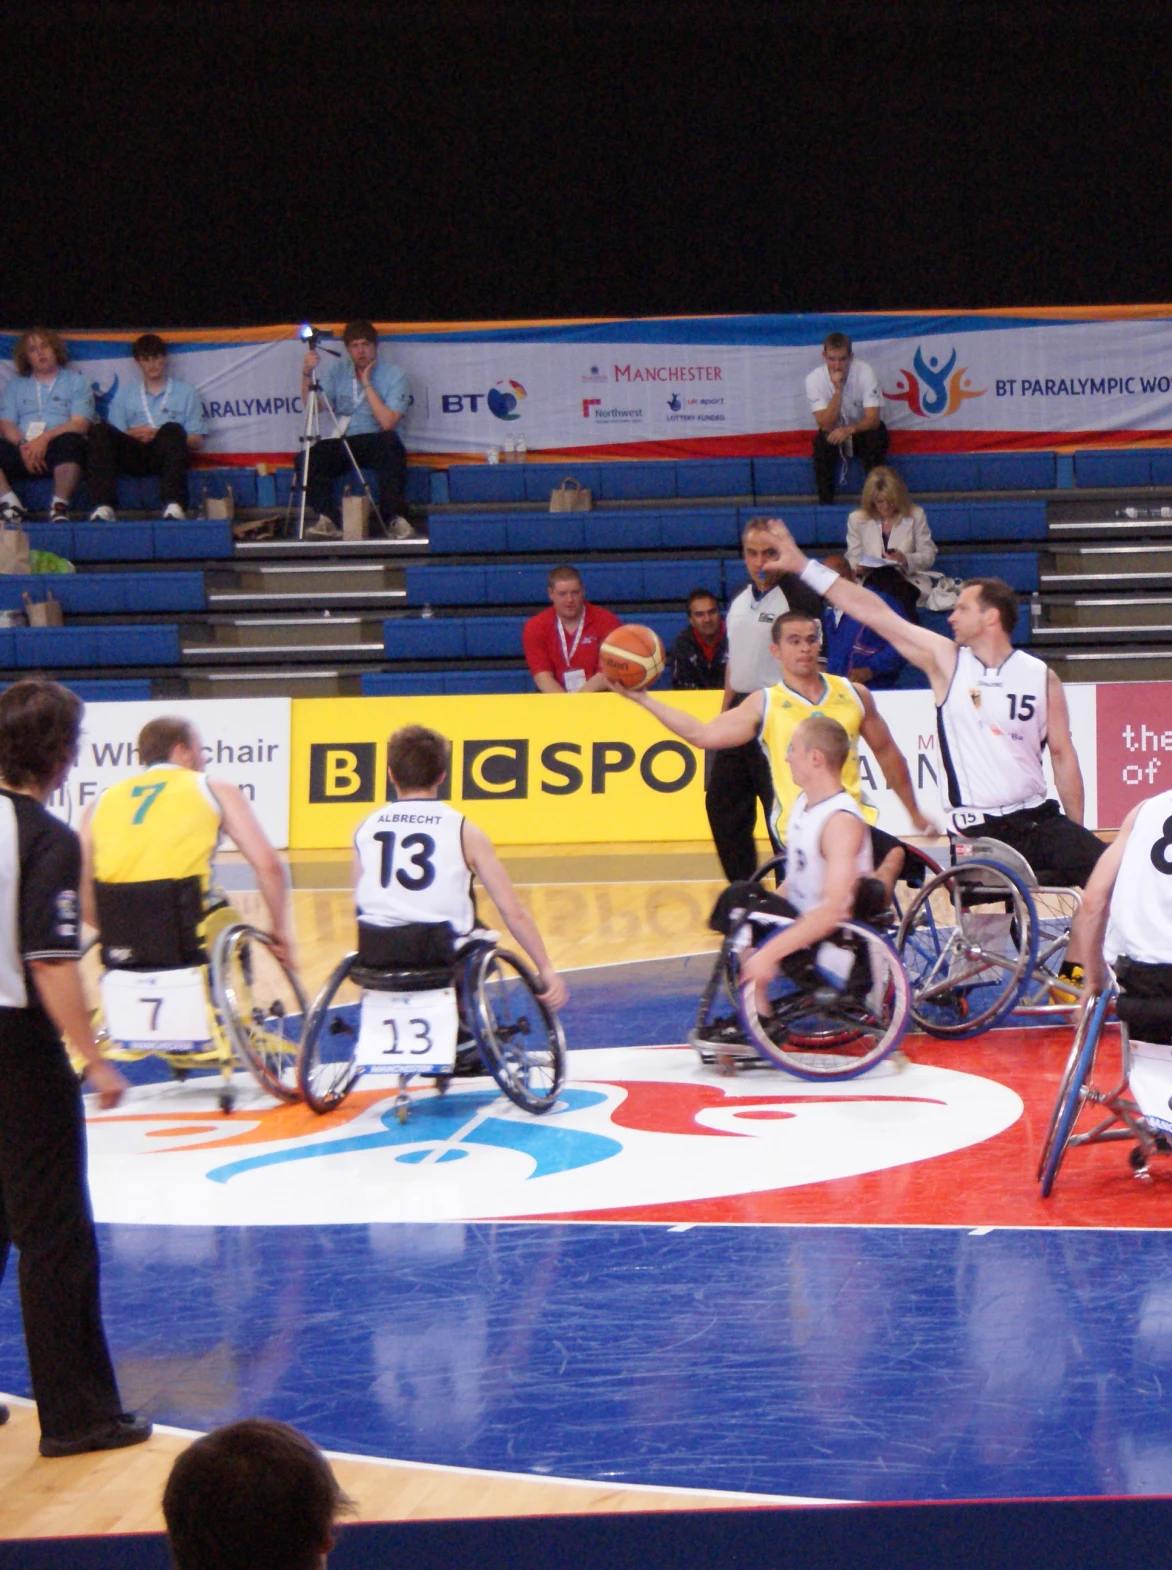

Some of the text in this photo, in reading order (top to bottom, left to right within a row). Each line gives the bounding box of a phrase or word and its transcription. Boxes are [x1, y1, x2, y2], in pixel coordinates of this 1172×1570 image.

[613, 364, 723, 383] MANCHESTER
[996, 379, 1018, 397] BT
[1021, 376, 1136, 396] PARALYMPIC
[201, 396, 303, 419] ARALYMPIC
[442, 394, 485, 413] BT
[595, 408, 643, 418] Northwest
[1006, 693, 1036, 722] 15
[92, 738, 280, 768] Whchair
[316, 743, 522, 801] BC
[540, 739, 711, 796] SPO
[1122, 756, 1162, 785] of
[130, 781, 167, 825] 7
[377, 814, 443, 825] ALBRECHT
[960, 813, 977, 825] 15
[373, 830, 436, 892] 13
[139, 997, 164, 1031] 7
[382, 1017, 433, 1055] 13
